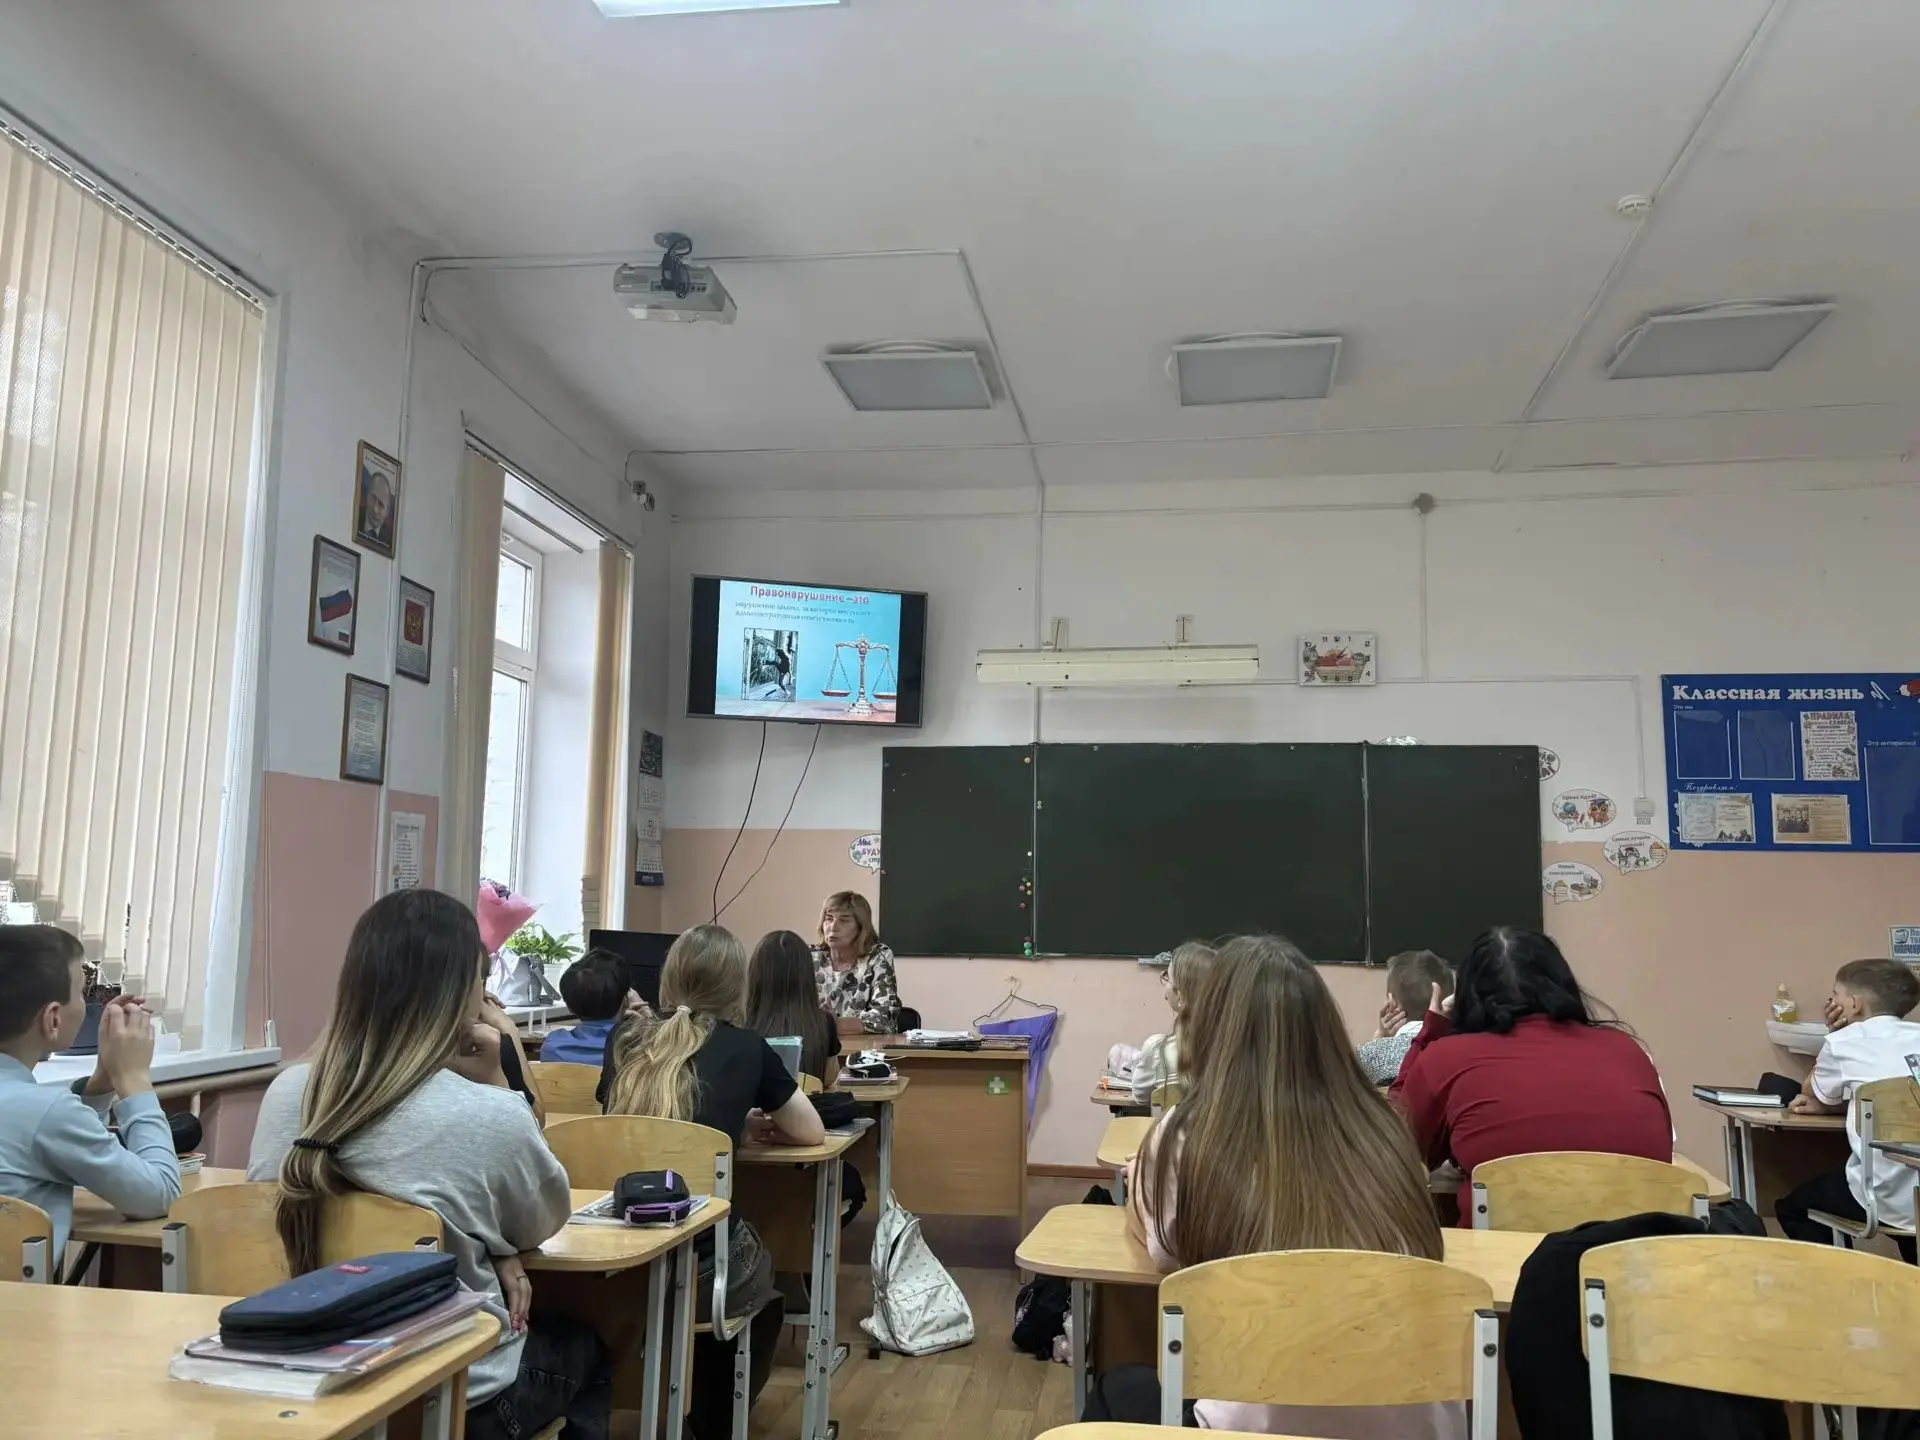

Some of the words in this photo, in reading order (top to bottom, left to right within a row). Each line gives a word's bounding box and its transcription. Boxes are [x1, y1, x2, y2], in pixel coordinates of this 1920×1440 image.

[750, 586, 844, 603] Правонарушение
[1672, 685, 1781, 700] Классная
[1787, 688, 1865, 700] жизнь
[1810, 712, 1850, 720] ПРАВИЛА
